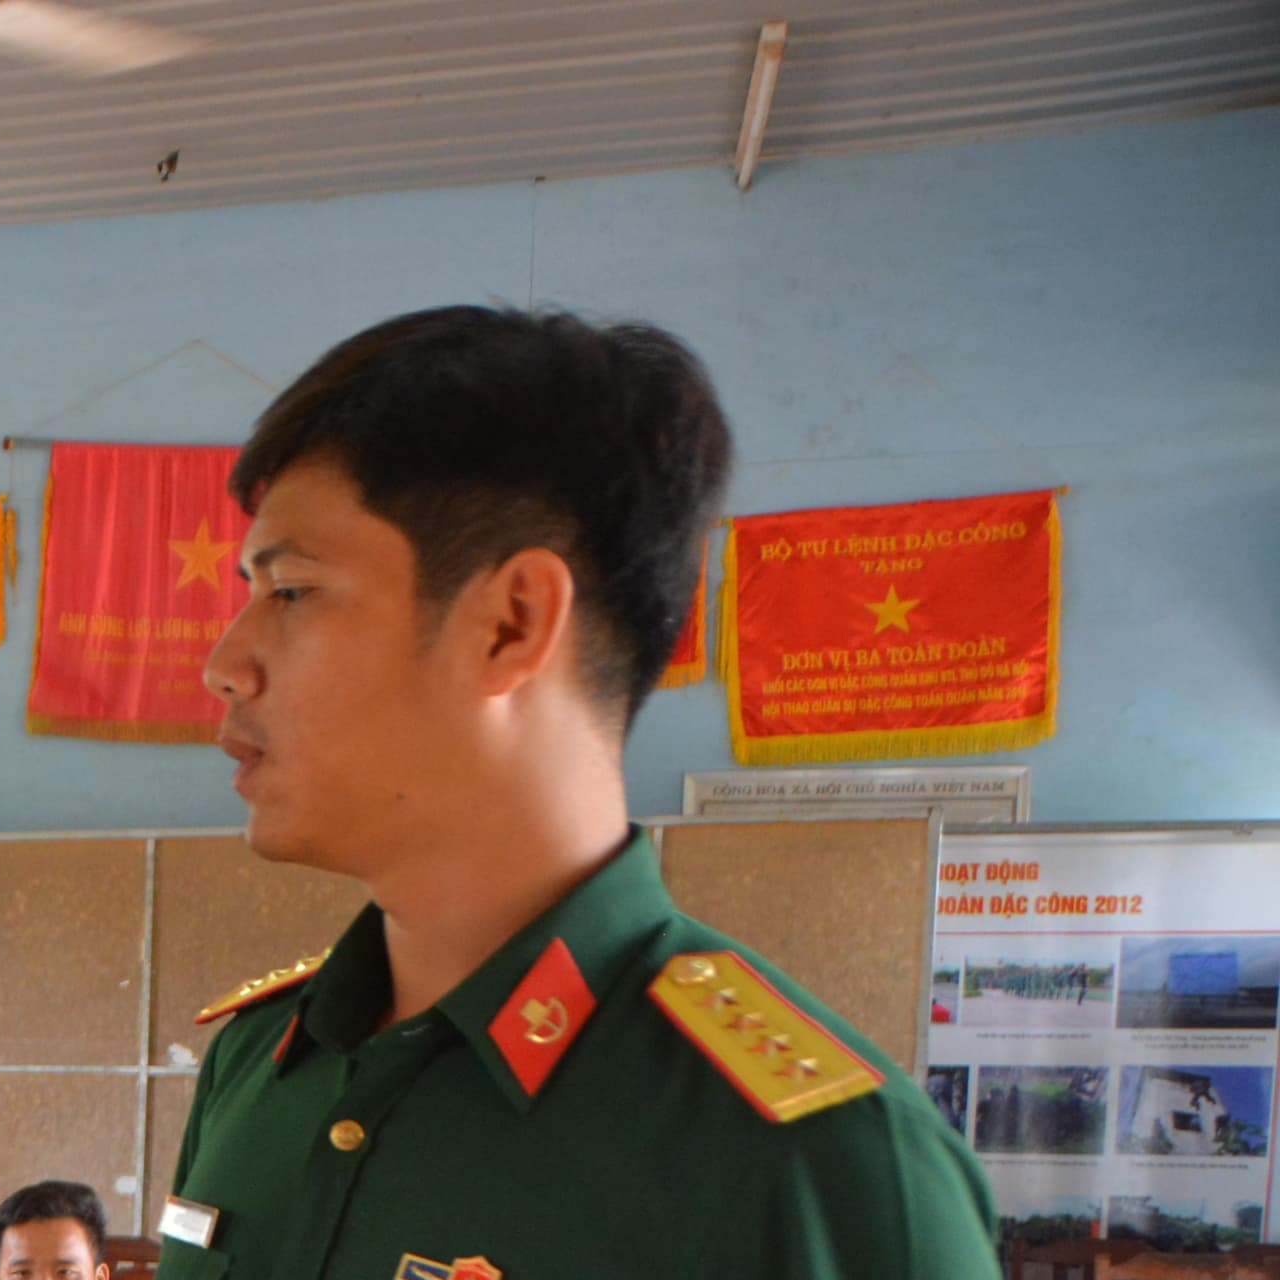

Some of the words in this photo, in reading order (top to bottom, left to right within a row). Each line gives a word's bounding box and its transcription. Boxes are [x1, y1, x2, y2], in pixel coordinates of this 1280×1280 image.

[761, 538, 792, 561] BỘ
[958, 521, 1028, 546] CÔNG
[783, 649, 823, 672] ĐƠN
[828, 650, 851, 674] VỊ
[856, 648, 881, 668] BA
[985, 858, 1040, 886] ĐỘNG
[990, 892, 1028, 919] ĐẶC
[1035, 891, 1088, 915] CÔNG
[1093, 894, 1144, 915] 2012
